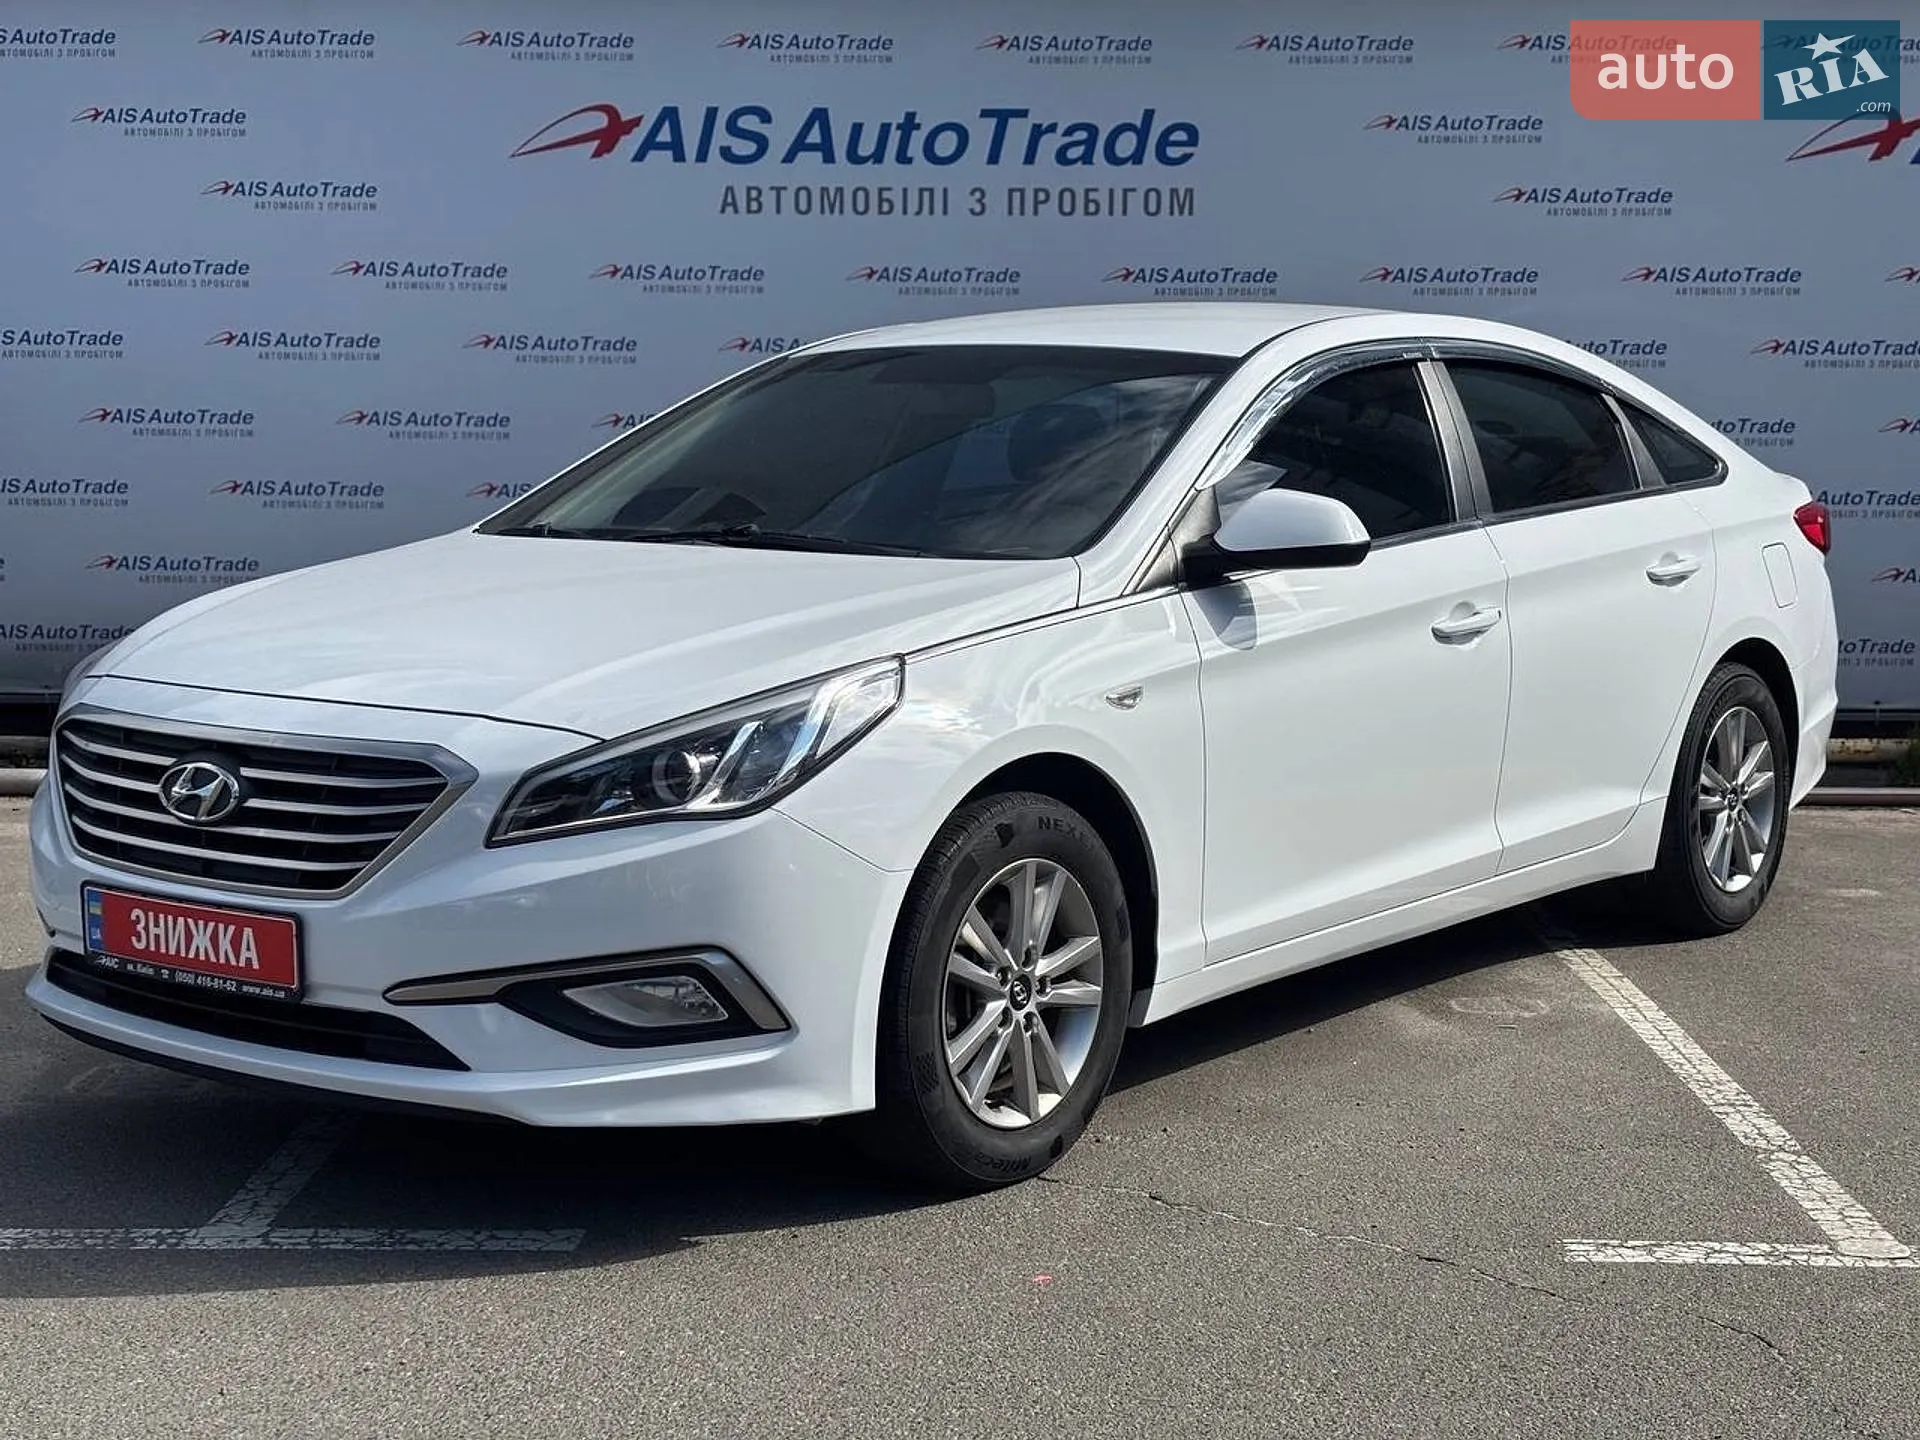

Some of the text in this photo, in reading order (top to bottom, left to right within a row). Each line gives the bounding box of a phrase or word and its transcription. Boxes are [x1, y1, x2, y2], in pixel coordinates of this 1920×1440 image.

[229, 29, 264, 46] AIS
[488, 31, 524, 48] AIS
[748, 34, 783, 51] AIS
[1007, 35, 1042, 52] AIS
[1266, 35, 1302, 52] AIS
[1529, 34, 1565, 51] AIS
[102, 107, 137, 125] AIS
[1395, 115, 1431, 132] AIS
[631, 105, 1200, 166] AIS AutoTrade
[232, 181, 267, 198] AIS
[1525, 187, 1561, 204] AIS
[719, 185, 1195, 217] АВТОМОБІЛІ З ПРОБІГОМ
[106, 258, 141, 276] AIS
[363, 261, 398, 278] AIS
[621, 264, 656, 282] AIS
[877, 266, 912, 283] AIS
[1133, 266, 1168, 284] AIS
[1391, 267, 1427, 284] AIS
[1654, 266, 1690, 283] AIS
[236, 331, 271, 349] AIS
[494, 334, 529, 352] AIS
[1782, 339, 1818, 356] AIS
[110, 407, 145, 425] AIS
[367, 410, 402, 428] AIS
[241, 479, 276, 497] AIS
[116, 554, 151, 572] AIS
[130, 908, 260, 970] ЗНИЖКА
